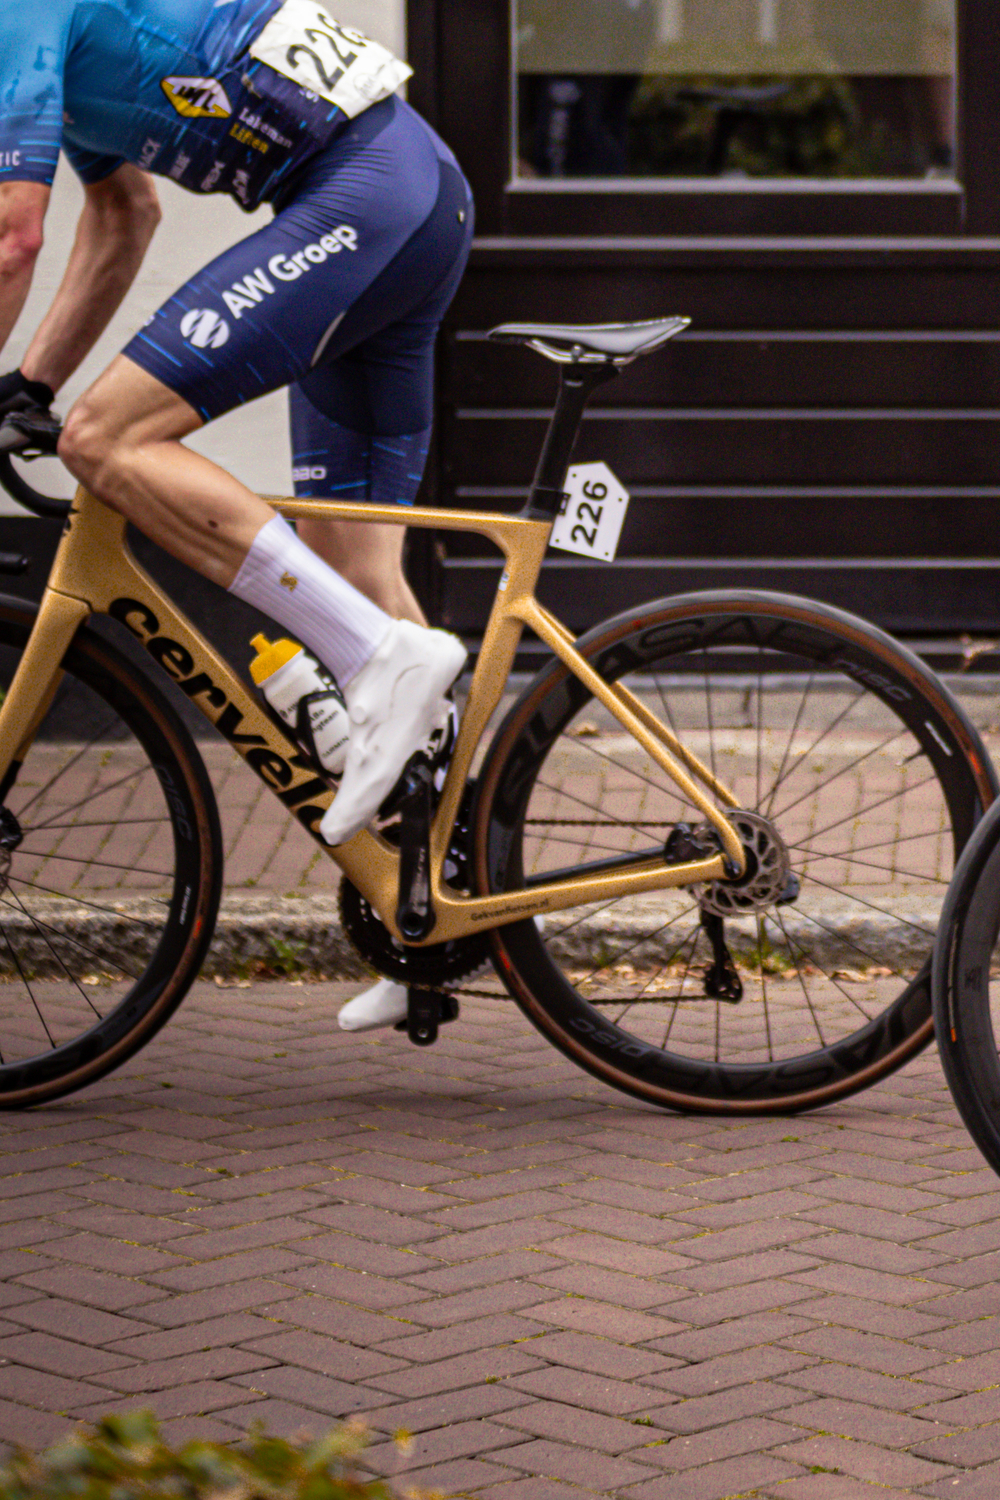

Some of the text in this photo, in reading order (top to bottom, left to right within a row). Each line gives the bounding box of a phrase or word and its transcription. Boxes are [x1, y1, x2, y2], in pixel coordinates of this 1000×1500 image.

[229, 123, 270, 154] Liften
[238, 107, 293, 149] Lakeman
[221, 224, 358, 319] AW Groep
[570, 480, 608, 548] 226
